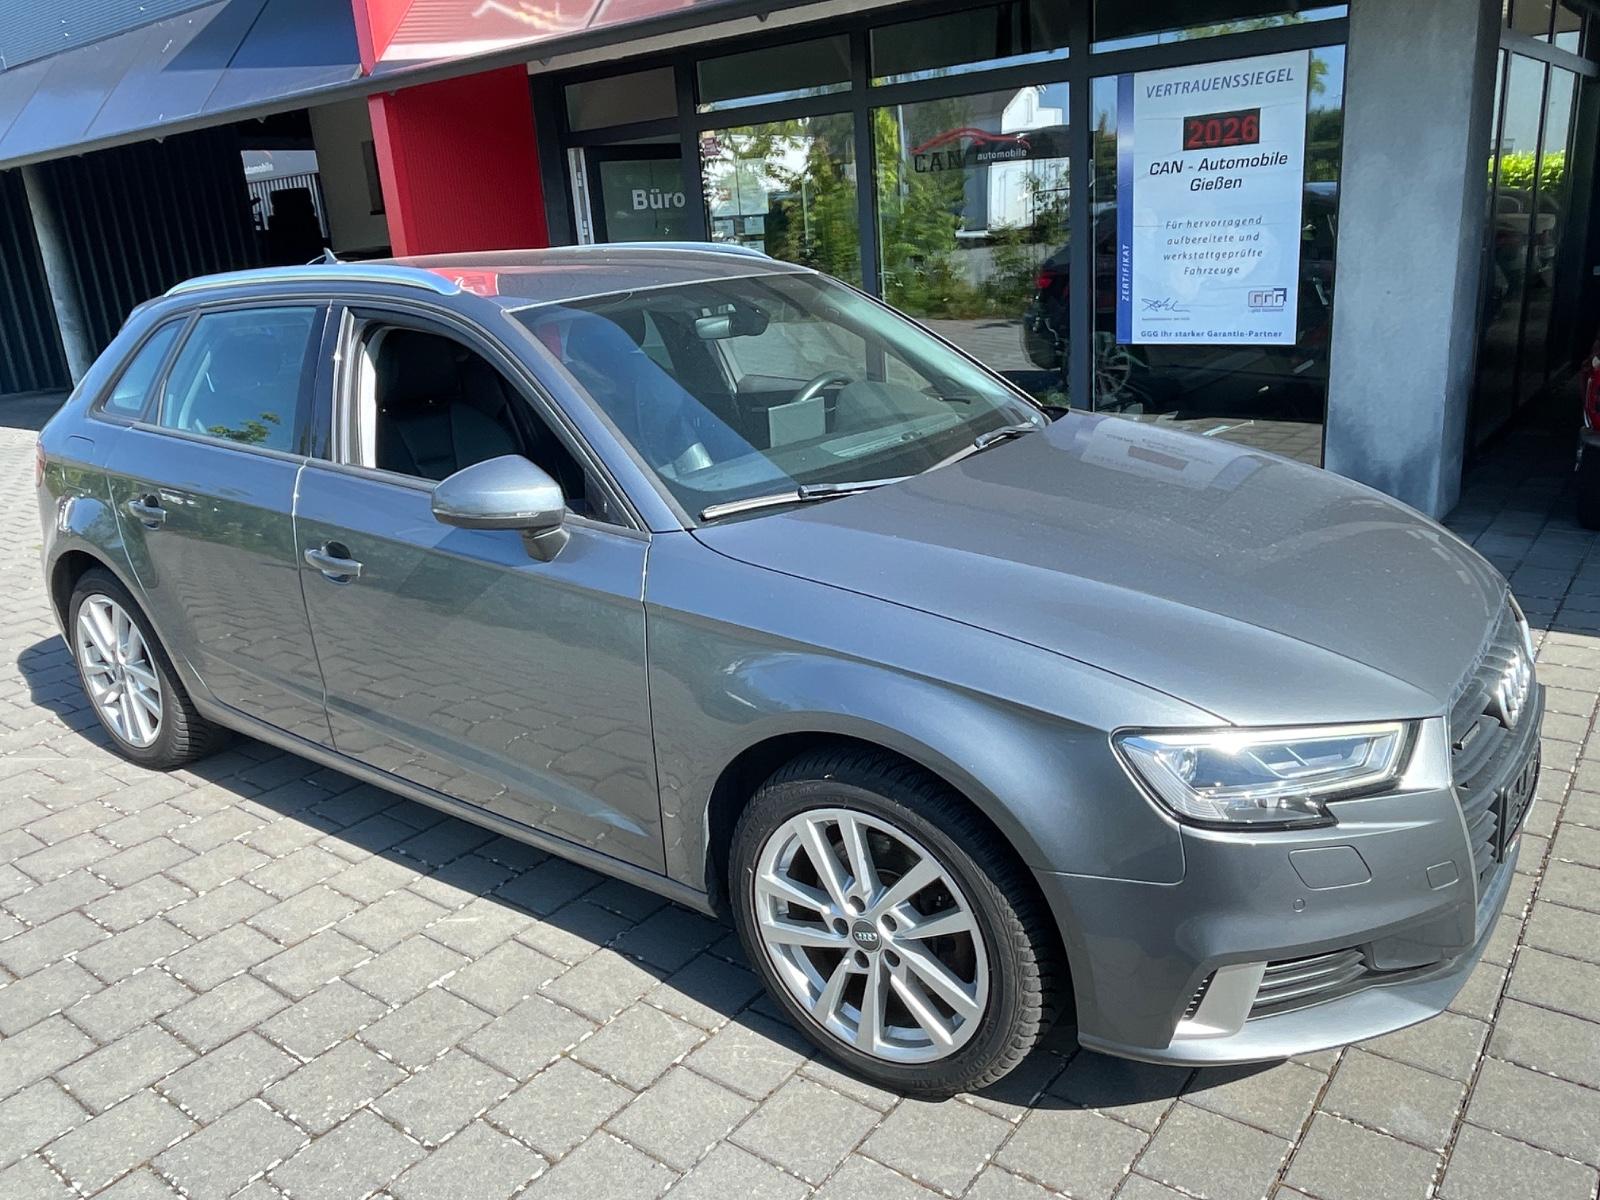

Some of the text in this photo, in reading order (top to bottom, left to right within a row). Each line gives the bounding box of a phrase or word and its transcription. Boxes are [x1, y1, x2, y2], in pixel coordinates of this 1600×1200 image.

[1146, 67, 1294, 98] VERTRAUENSSIEGEL
[1187, 113, 1258, 148] 2026
[977, 148, 1027, 161] automobile
[1150, 159, 1184, 176] CAN
[1198, 151, 1288, 172] Automobile
[1190, 176, 1242, 192] Gießen
[632, 188, 686, 210] Büro
[1166, 215, 1263, 230] Für hervorragend
[1167, 231, 1260, 246] aufbereitete und
[1163, 247, 1263, 261] werkstattgeprüfte
[1121, 244, 1130, 301] ZERTIFIKAT
[1184, 265, 1240, 277] Fahrzeuge
[1141, 329, 1282, 338] GGG Ihr starker Garantie-Partner
